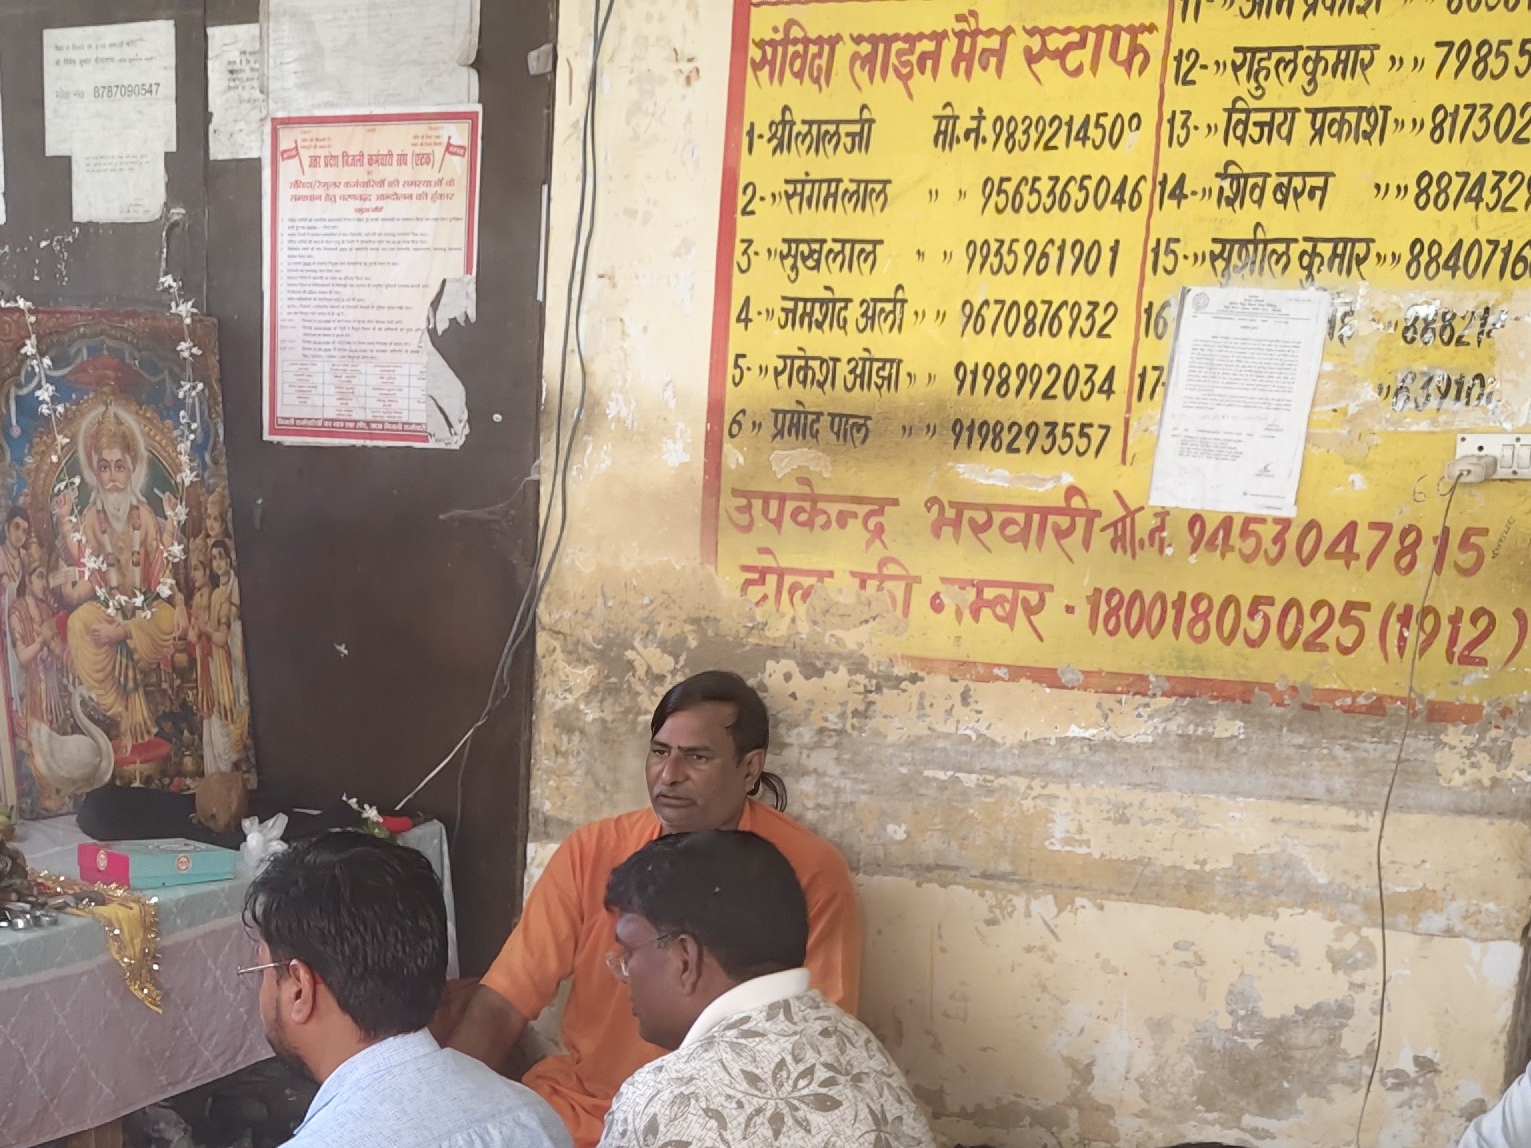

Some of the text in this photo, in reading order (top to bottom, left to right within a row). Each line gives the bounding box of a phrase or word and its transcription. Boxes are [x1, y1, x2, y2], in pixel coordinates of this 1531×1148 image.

[750, 10, 1158, 100] संविदा लाइन मैन स्टाफ
[1302, 44, 1380, 96] कुमार
[93, 83, 161, 99] 8787090547
[1223, 96, 1301, 147] विजय
[1304, 105, 1392, 146] प्रकाश
[1430, 102, 1531, 145] 817302
[981, 175, 1147, 215] 9565365046
[1215, 160, 1272, 214] शिव
[1272, 171, 1336, 211] बरन
[1414, 170, 1531, 212] 887432
[965, 239, 1120, 277] 9935961901
[1297, 236, 1376, 290] कुमार
[1405, 237, 1531, 282] 8840716
[777, 286, 853, 334] जमशेद
[856, 285, 908, 335] अली
[960, 300, 1118, 339] 9670876932
[774, 348, 840, 395] राकेश
[844, 349, 903, 394] ओझा
[954, 362, 1116, 401] 9198992034
[771, 400, 824, 443] प्रमोद
[827, 413, 871, 446] पाल
[951, 419, 1111, 459] 9198293557
[725, 478, 900, 550] उपकेन्द्र
[924, 485, 1102, 564] भरवारी
[1188, 513, 1489, 578] 9453047815
